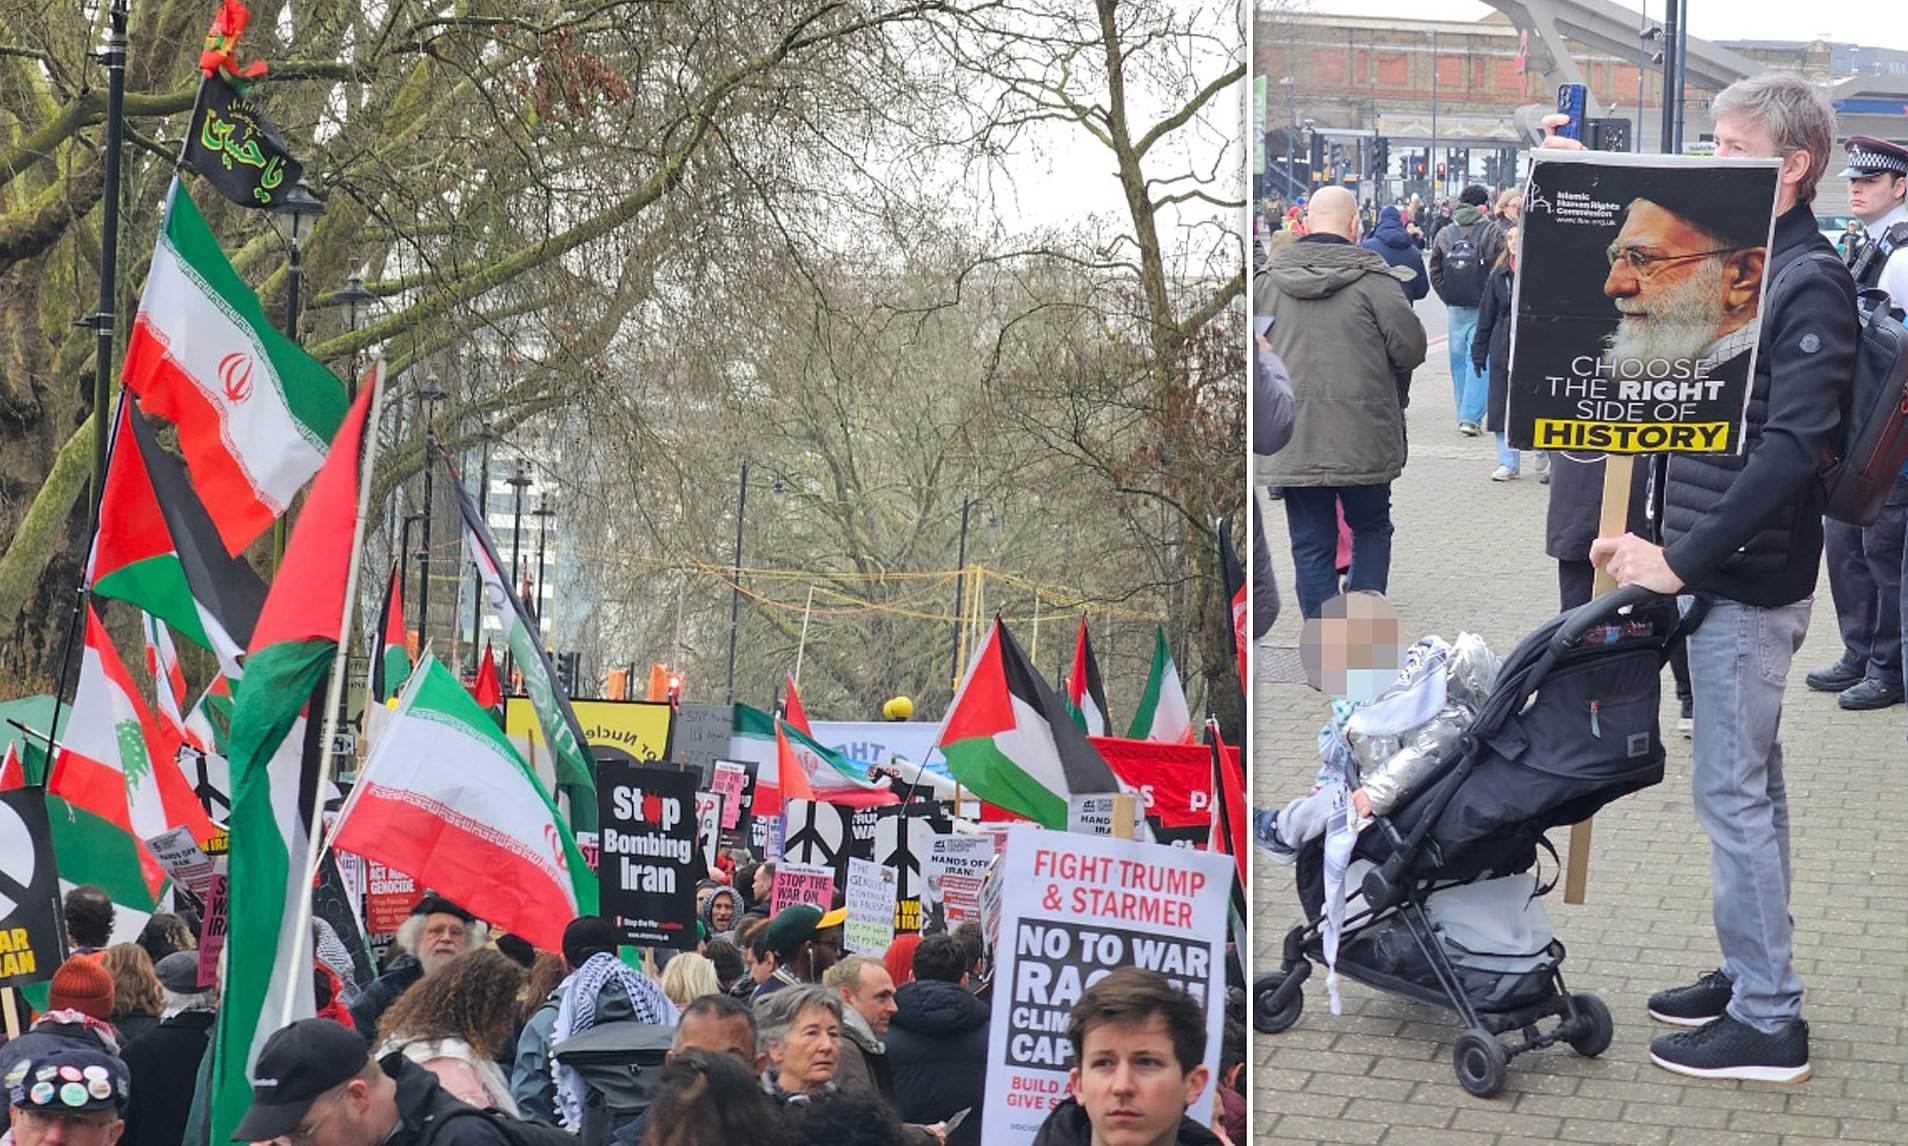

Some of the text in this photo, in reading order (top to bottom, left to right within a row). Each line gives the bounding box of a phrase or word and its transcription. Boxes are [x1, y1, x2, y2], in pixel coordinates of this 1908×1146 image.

[1557, 191, 1590, 200] Islamic
[1557, 200, 1620, 210] Human Rights
[1556, 207, 1612, 217] Commission
[1571, 356, 1710, 379] CHOOSE
[1546, 376, 1726, 401] THE RIGHT
[1576, 401, 1697, 422] SIDE OF
[1543, 423, 1724, 449] HISTORY
[613, 786, 680, 831] Stop
[1081, 815, 1111, 825] HAND
[604, 829, 691, 864] Bombing
[931, 855, 990, 868] HANDS OFF
[620, 857, 676, 893] Iran
[778, 873, 830, 890] STOP THE
[1034, 850, 1206, 898] FIGHT TRUMP
[370, 880, 416, 895] GENOCIDE
[777, 887, 819, 901] WAR ON
[1042, 883, 1062, 912] &
[1071, 886, 1193, 929] STARMER
[0, 928, 30, 953] AR
[1018, 924, 1209, 978] NO TO WAR
[1012, 1076, 1059, 1094] BUILD
[1007, 1094, 1043, 1109] GIVE
